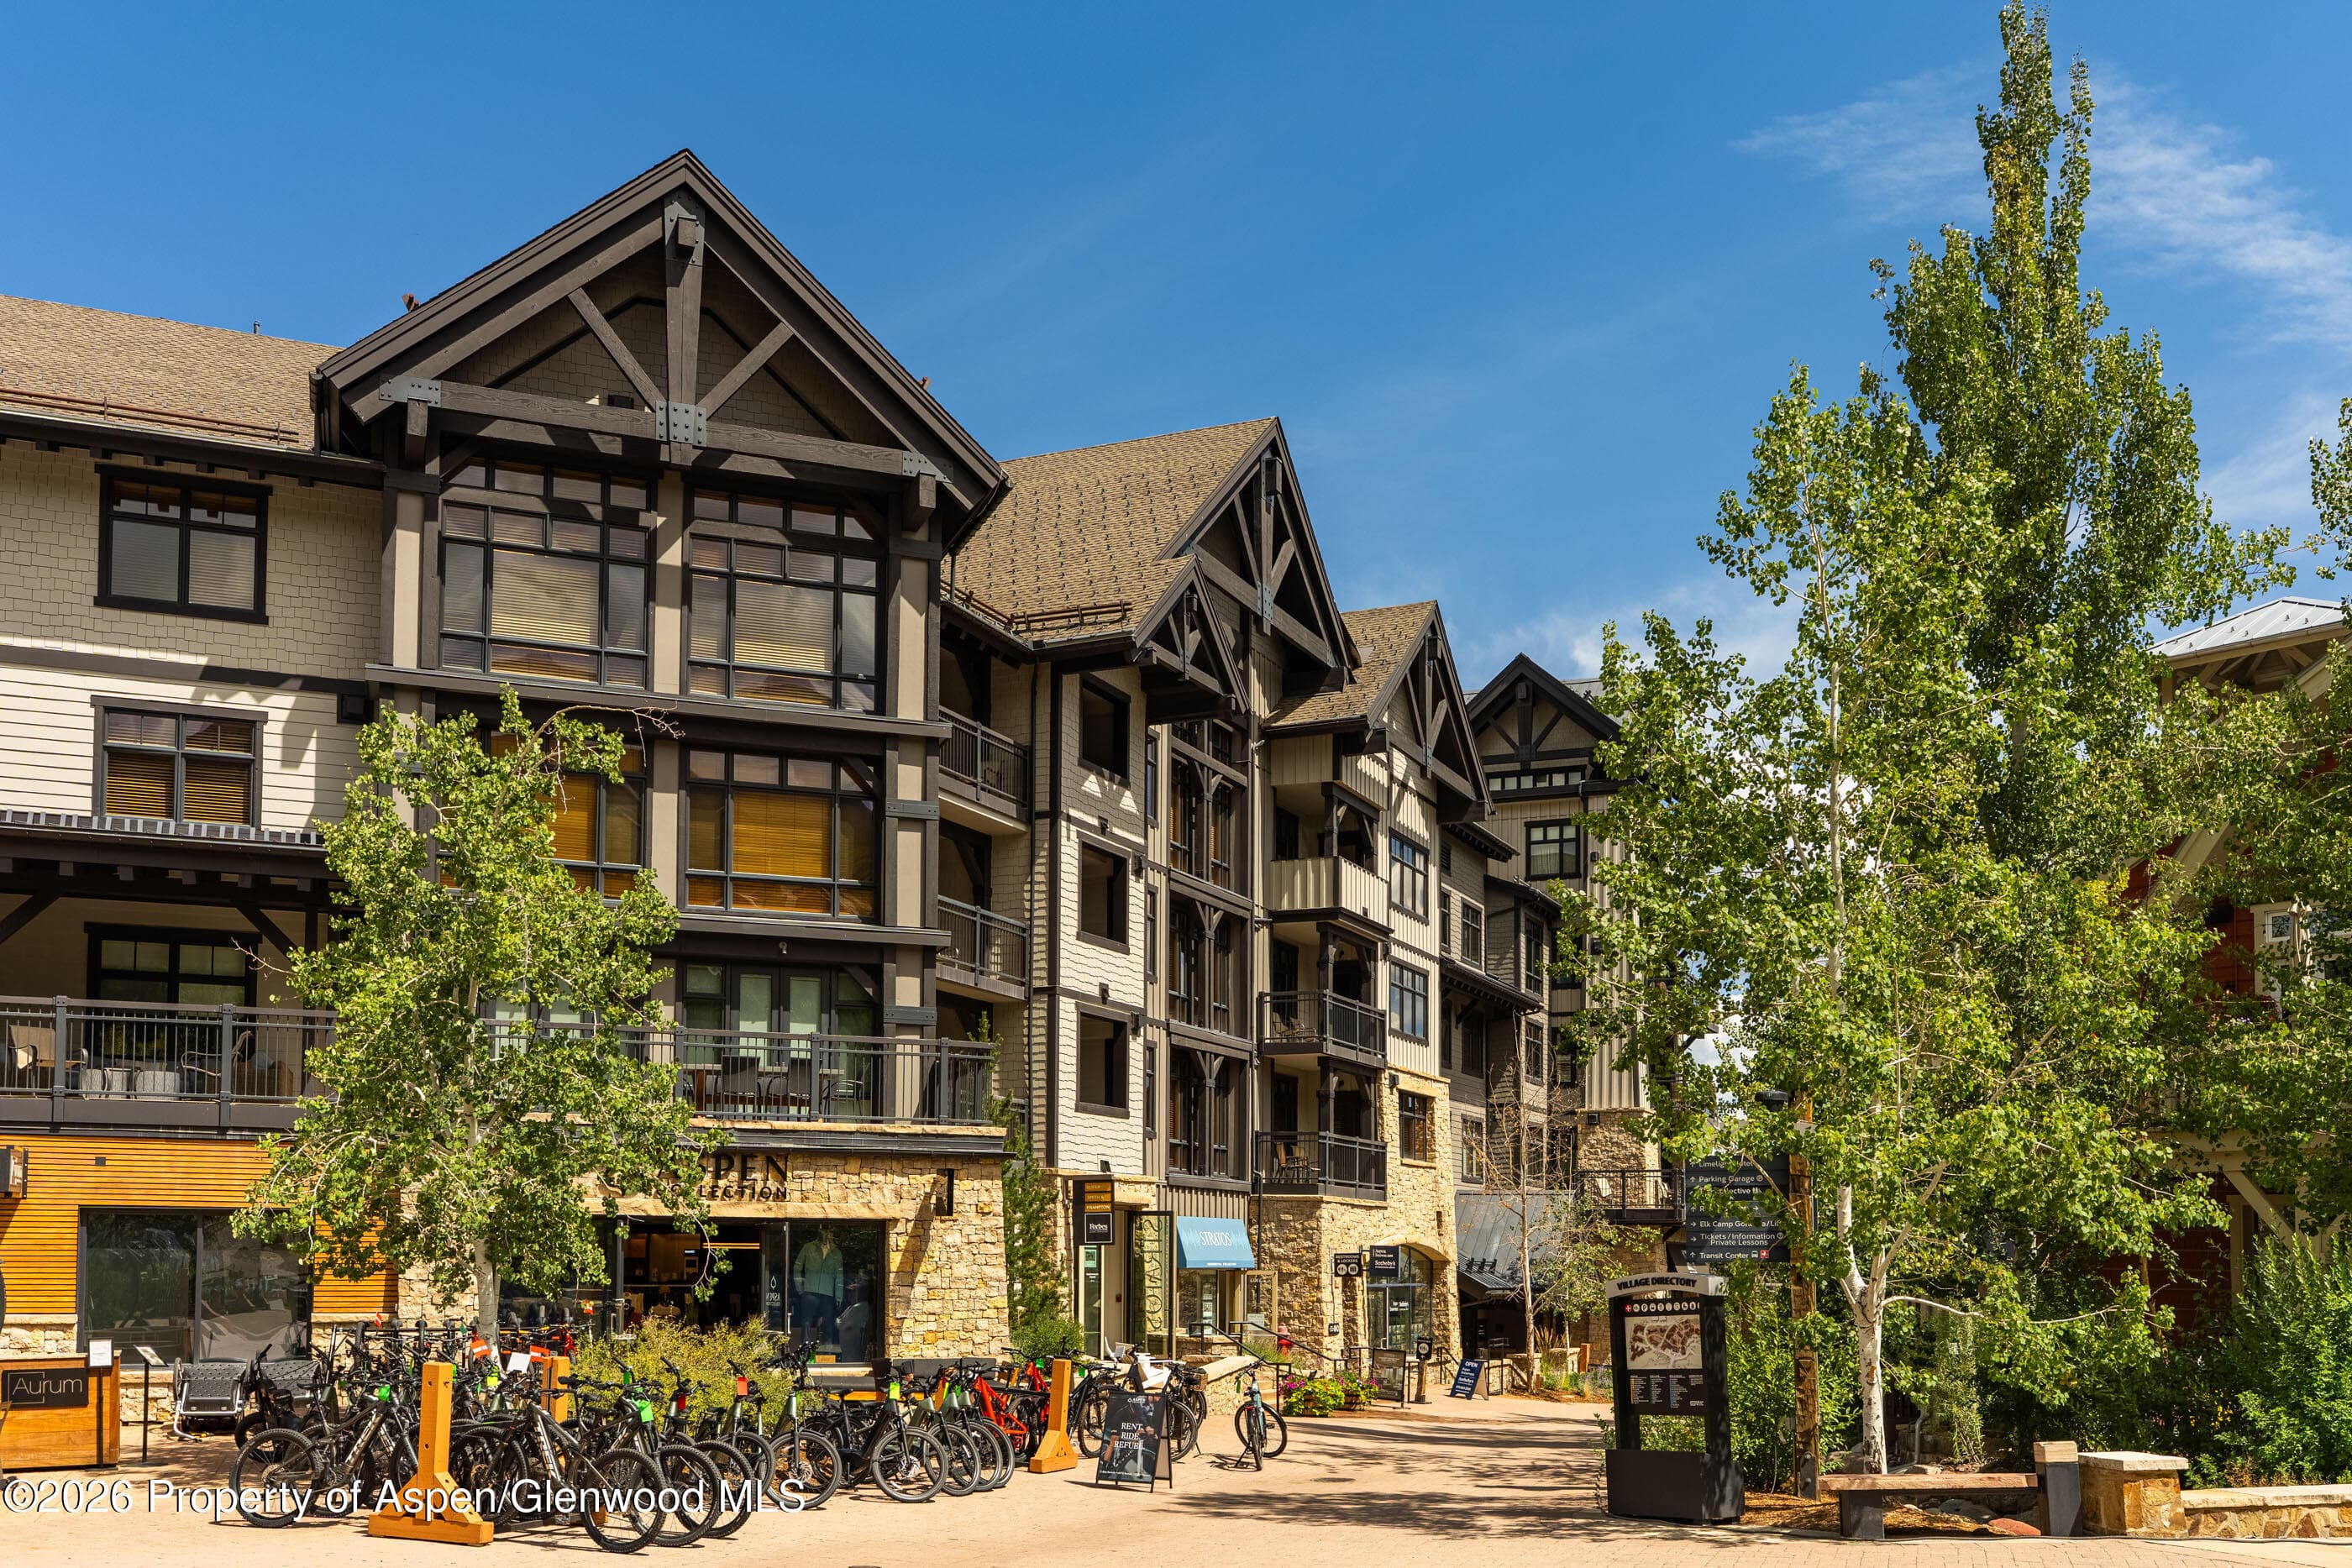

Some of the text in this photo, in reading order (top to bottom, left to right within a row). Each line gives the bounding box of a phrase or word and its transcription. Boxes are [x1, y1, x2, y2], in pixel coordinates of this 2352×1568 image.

[1199, 1231, 1232, 1247] STRATOS
[1616, 1277, 1697, 1291] VILLAGE DIRECTORY
[12, 1377, 83, 1396] Aurum
